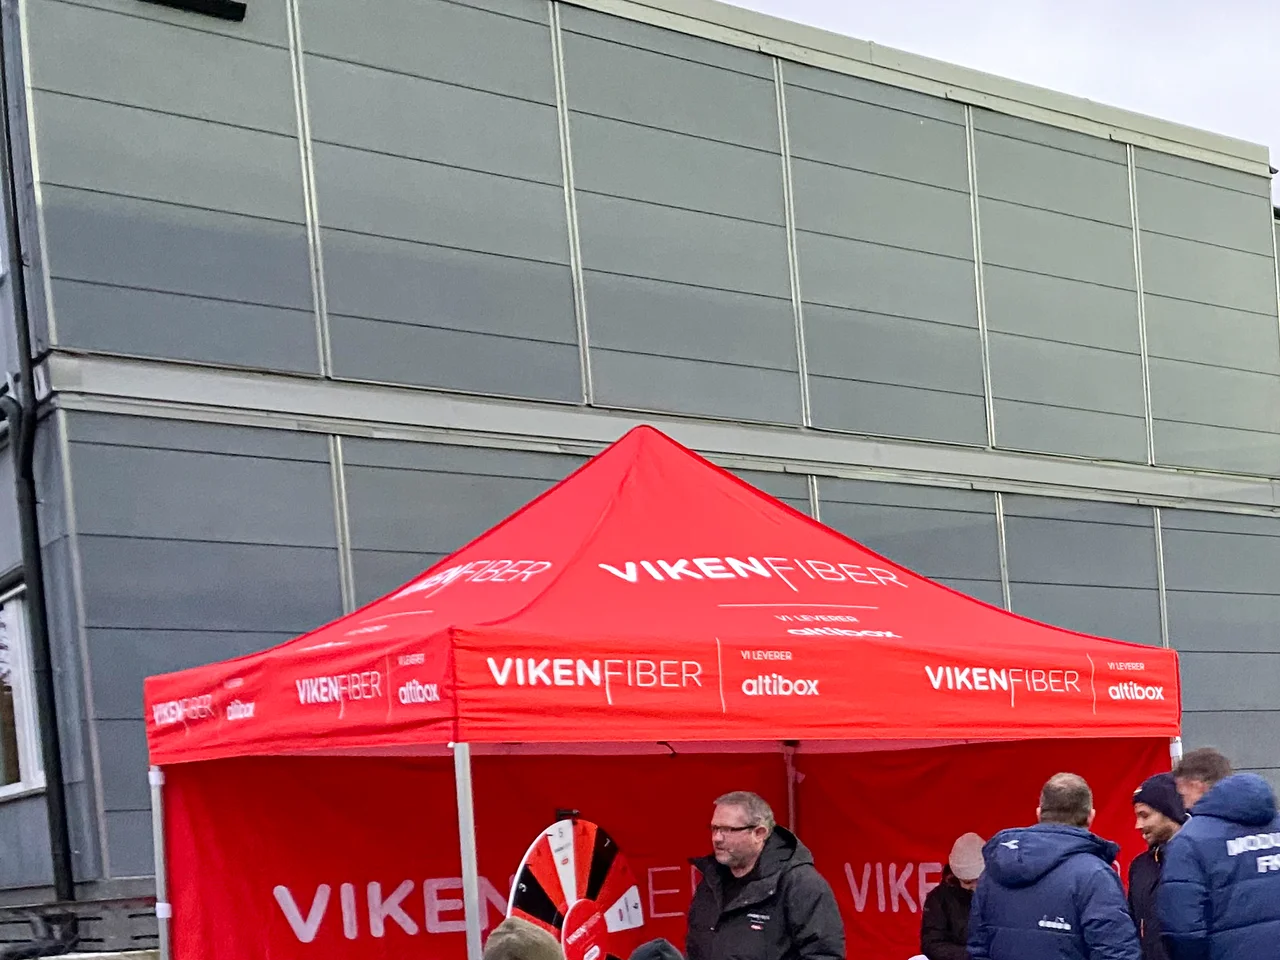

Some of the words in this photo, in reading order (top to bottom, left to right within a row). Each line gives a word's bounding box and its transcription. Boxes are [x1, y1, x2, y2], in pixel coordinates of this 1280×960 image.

[598, 556, 908, 592] VIKENFIBER
[787, 627, 903, 639] altibox
[741, 650, 750, 659] VI
[752, 650, 793, 660] LEVERER
[296, 670, 382, 720] VIKENFIBER
[487, 657, 703, 706] VIKENFIBER
[741, 673, 820, 696] altibox
[925, 665, 1081, 708] VIKENFIBER
[1108, 681, 1165, 701] altibox
